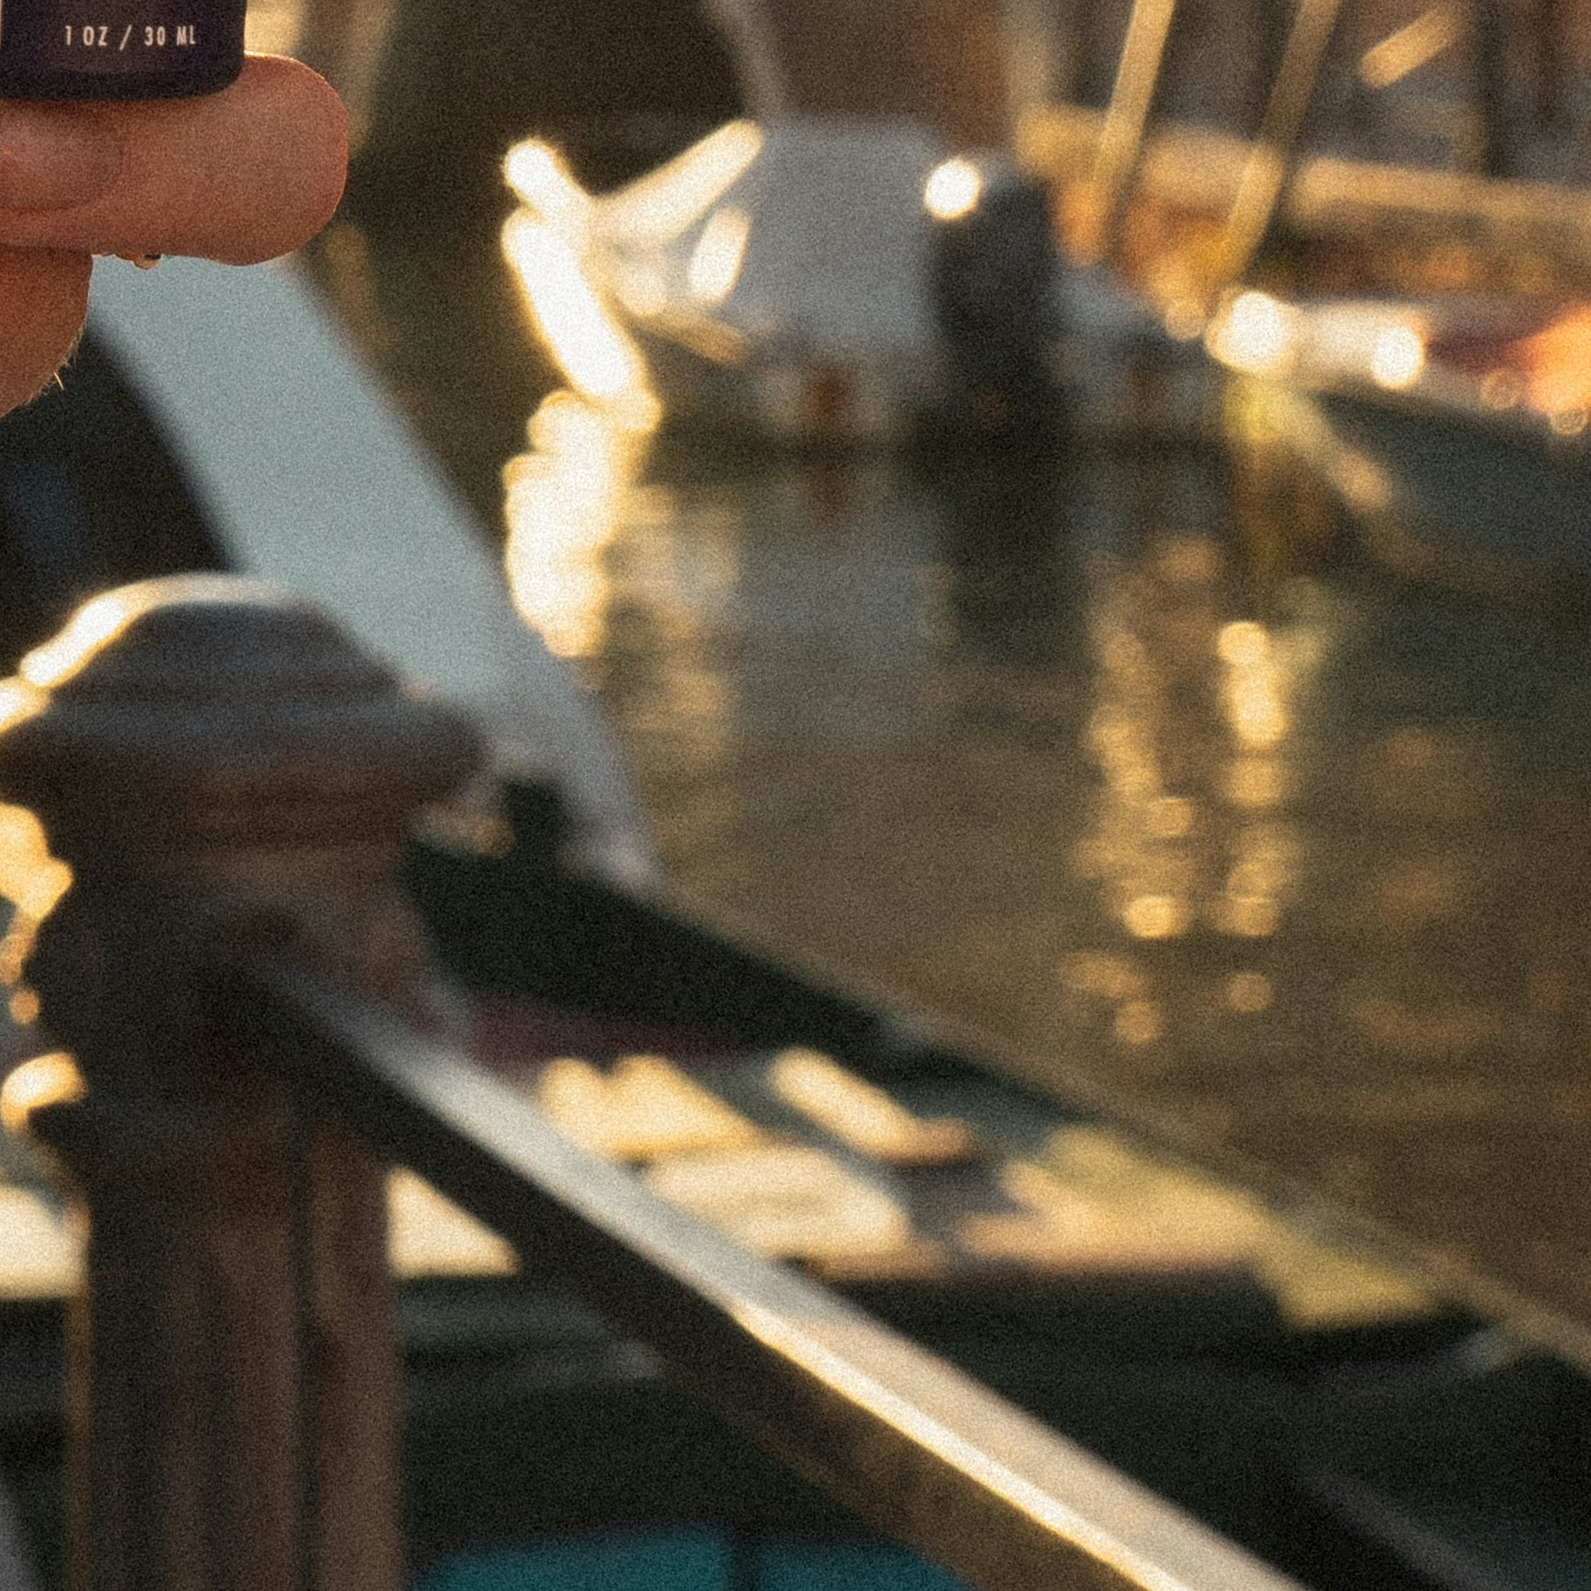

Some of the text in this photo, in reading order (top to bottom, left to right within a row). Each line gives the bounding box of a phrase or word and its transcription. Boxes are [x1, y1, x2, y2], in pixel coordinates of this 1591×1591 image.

[64, 25, 72, 47] 1
[82, 25, 109, 47] OZ
[144, 25, 166, 47] 30
[176, 24, 196, 47] ML
